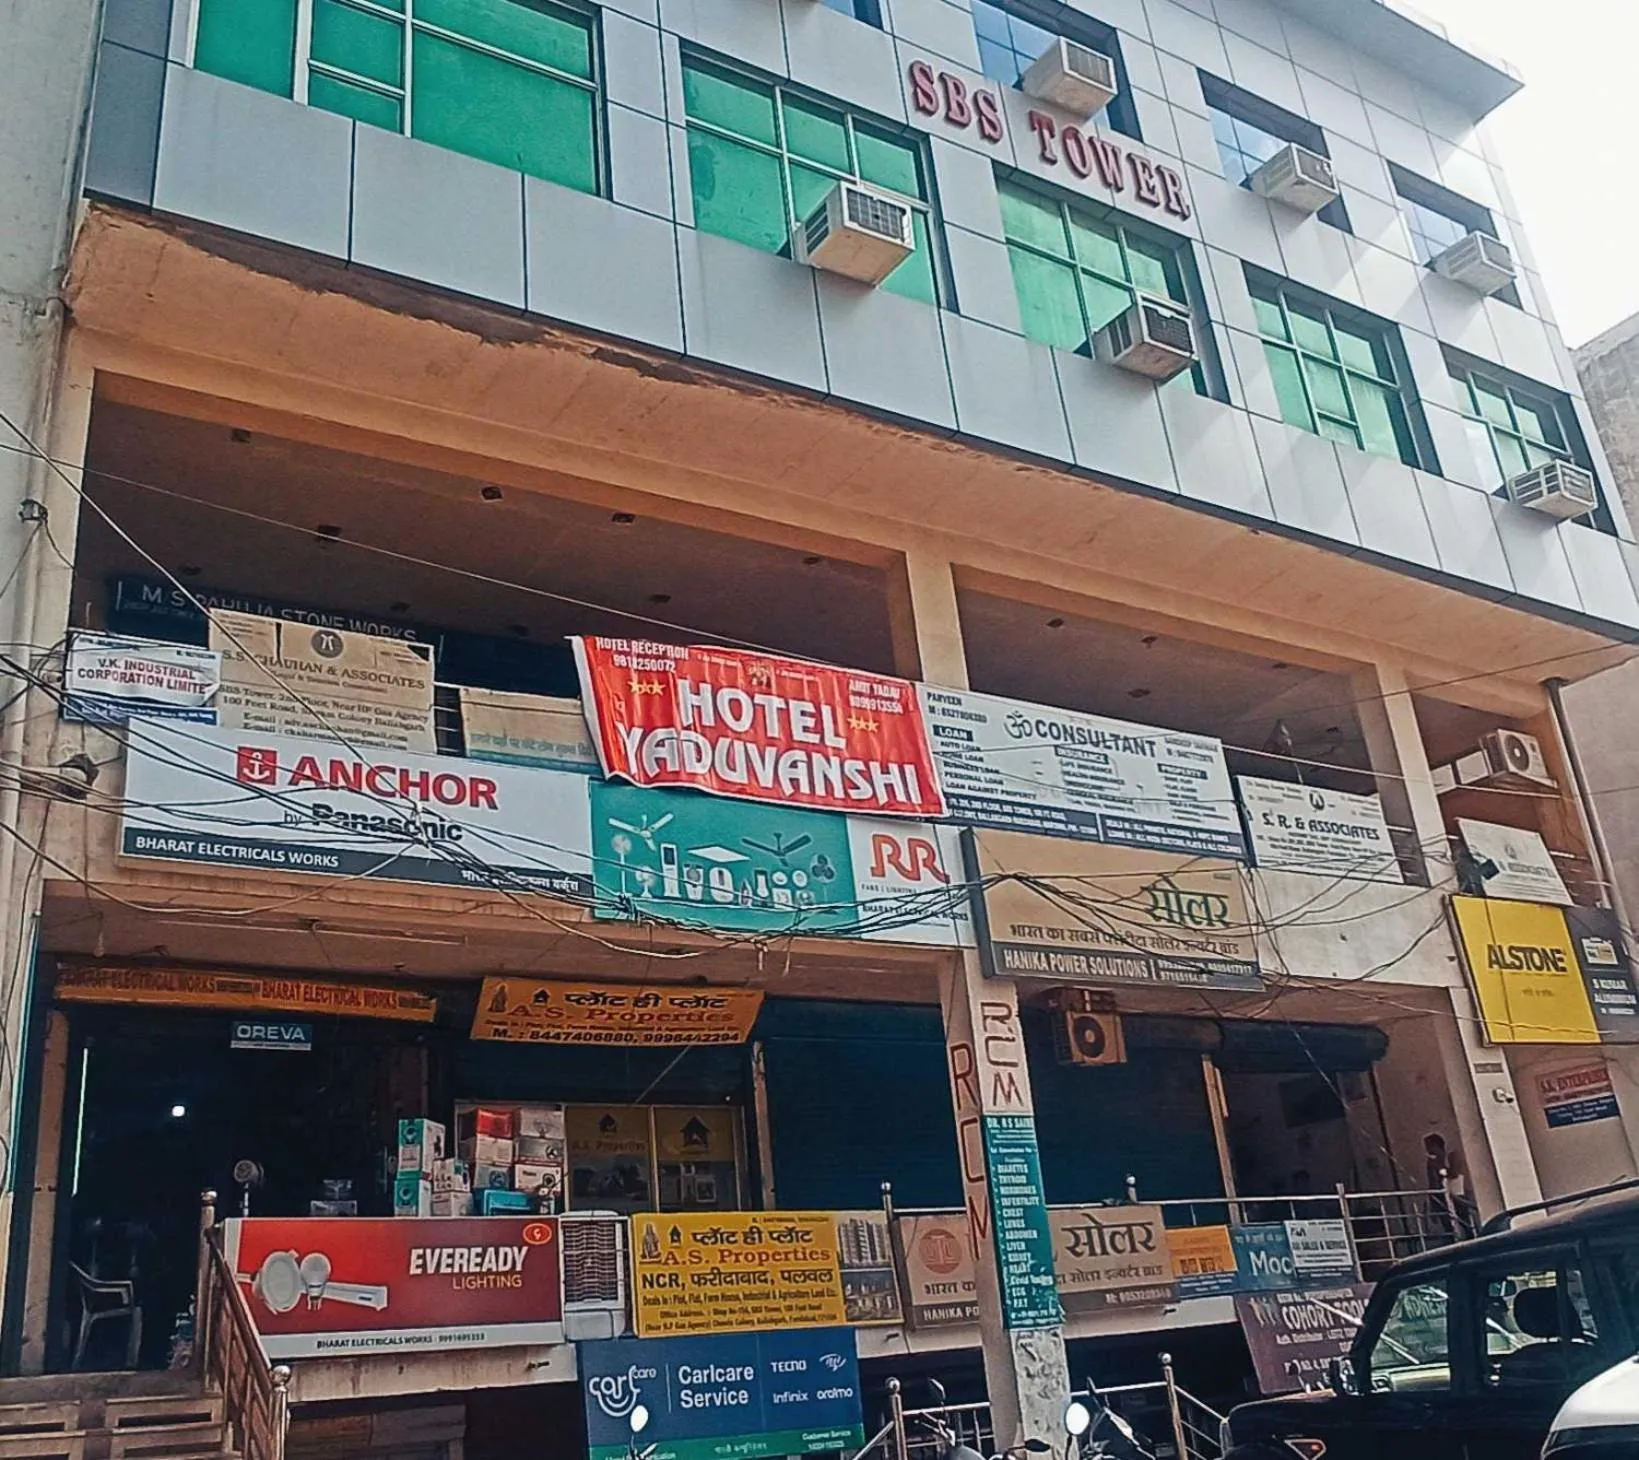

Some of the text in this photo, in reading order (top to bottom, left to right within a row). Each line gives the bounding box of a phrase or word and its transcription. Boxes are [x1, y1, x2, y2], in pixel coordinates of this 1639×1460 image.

[909, 60, 1192, 222] SBS TOWER
[596, 636, 630, 653] HOTEL
[631, 640, 689, 660] RECEPTION
[77, 668, 164, 688] CORPORATION
[124, 659, 196, 680] INDUSTRIAL
[327, 666, 338, 676] &
[341, 668, 425, 690] ASSOCIATES
[677, 678, 847, 749] HOTEL
[1034, 719, 1157, 759] CONSULTANT
[616, 722, 923, 806] YADUVANSHI
[288, 756, 498, 809] ANCHOR
[311, 803, 463, 841] Panasonic
[1295, 817, 1305, 831] &
[1308, 819, 1380, 841] ASSOCIATES
[135, 836, 339, 867] BHARAT ELECTRICALS WORKS
[870, 833, 950, 883] RR
[1010, 924, 1043, 939] भारत
[1046, 929, 1065, 939] का
[1004, 949, 1047, 969] HANIKA
[1050, 953, 1088, 974] POWER
[1090, 958, 1149, 979] SOLUTIONS
[1487, 944, 1568, 972] ALSTONE
[261, 979, 300, 1000] BHARAT
[303, 982, 362, 1007] ELECTRICAL
[507, 1005, 735, 1024] A.S. Properties
[236, 1023, 306, 1042] OREVA
[691, 1226, 813, 1246] प्लॉट ही प्लॉट
[1061, 1212, 1157, 1258] सोलर
[663, 1247, 830, 1266] A.S. Properties
[1007, 1242, 1026, 1251] LIVER
[409, 1246, 529, 1275] EVEREADY
[452, 1274, 522, 1290] LIGHTING
[642, 1272, 686, 1290] NCR,
[780, 1269, 833, 1284] पलवल
[924, 1282, 957, 1295] भारत
[923, 1308, 963, 1320] HANIKA
[317, 1340, 349, 1349] BHARAT
[351, 1336, 403, 1347] ELECTRICALS
[678, 1364, 754, 1385] Carlcare
[770, 1360, 807, 1373] TECNO
[680, 1387, 749, 1409] Service
[773, 1387, 853, 1404] Infinix oraimo
